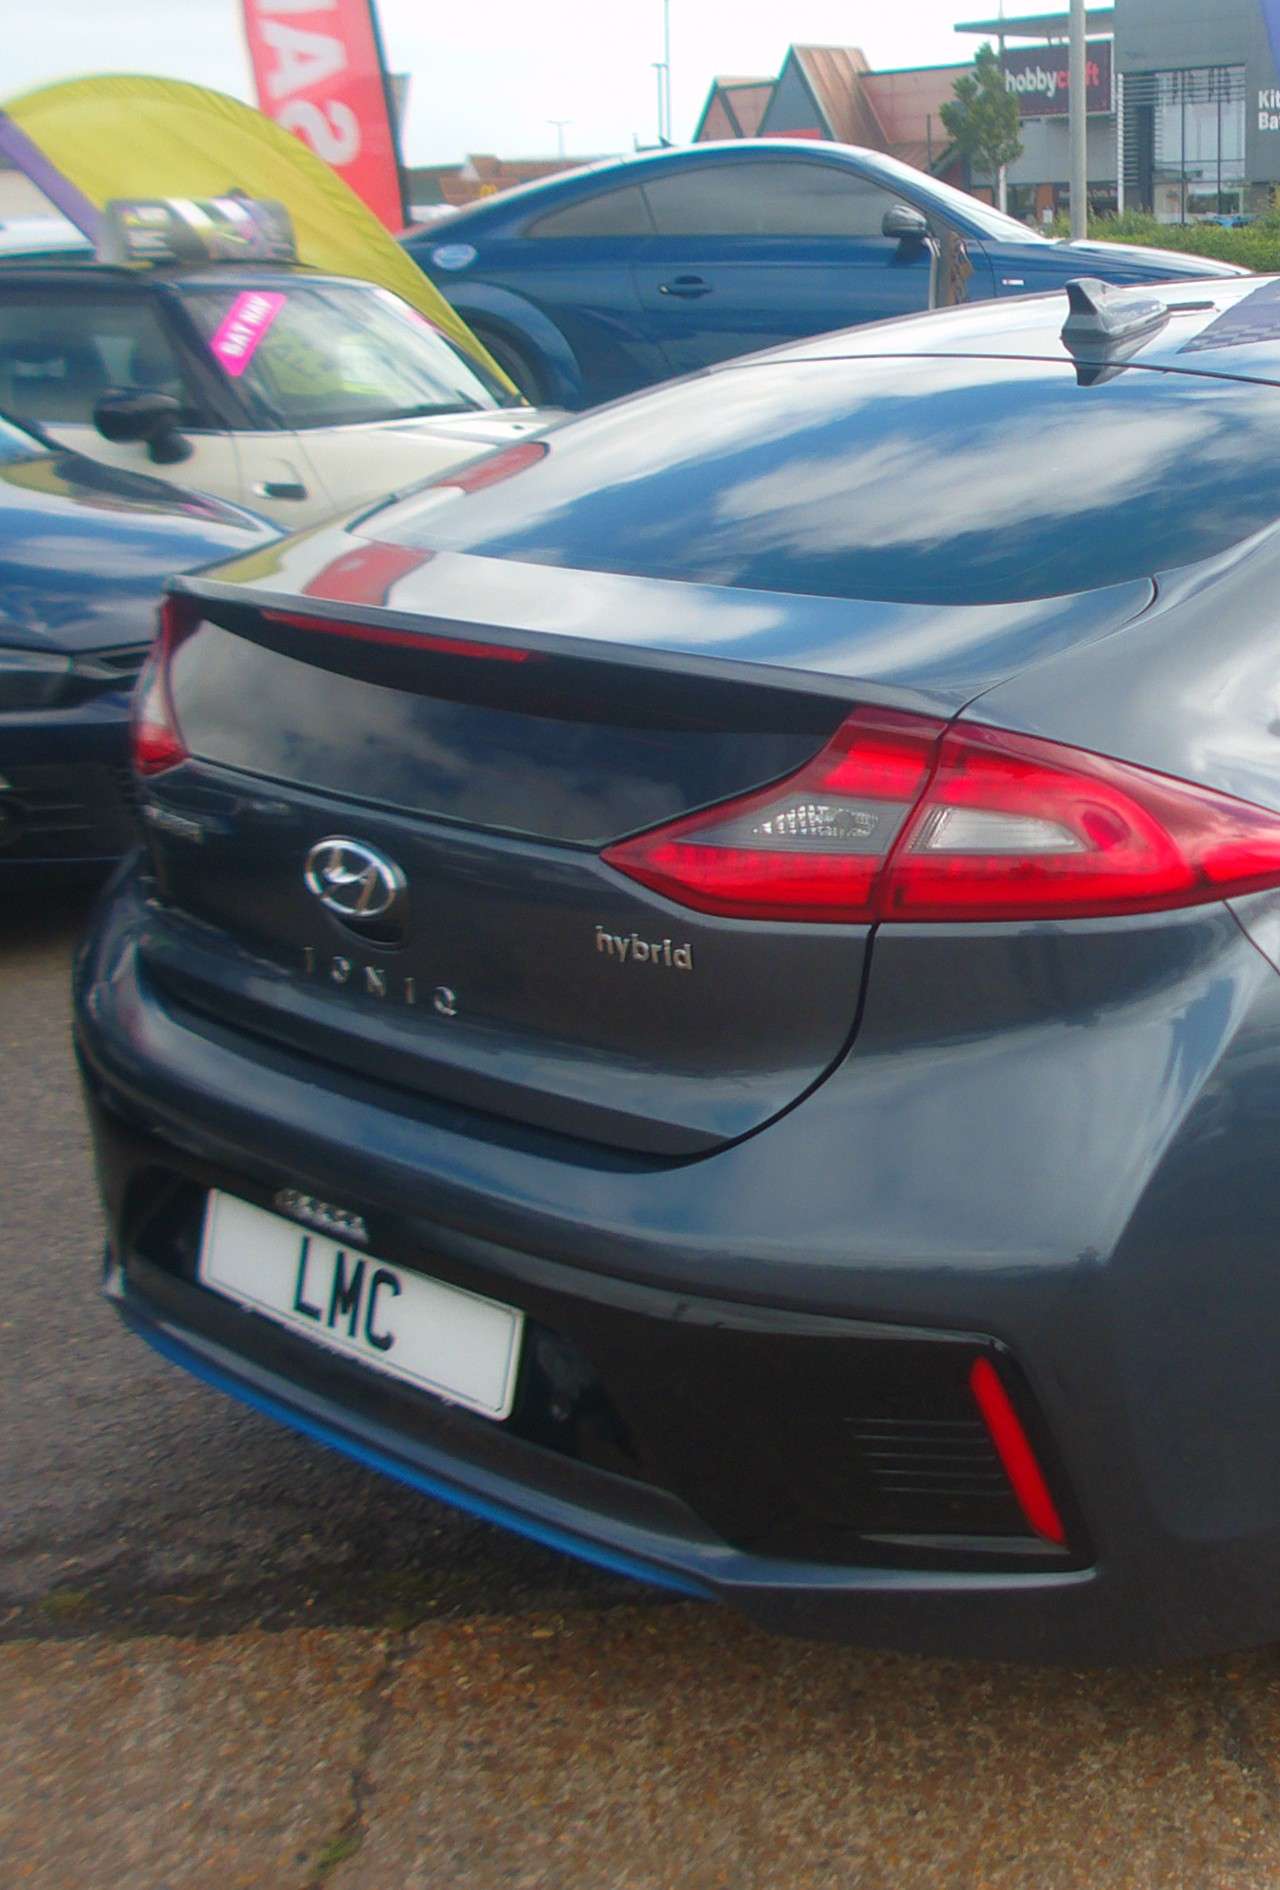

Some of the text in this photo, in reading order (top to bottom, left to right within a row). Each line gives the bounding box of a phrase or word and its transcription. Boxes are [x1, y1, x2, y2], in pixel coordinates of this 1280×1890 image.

[1004, 60, 1100, 98] hobbycft
[595, 925, 693, 970] hybrid
[304, 946, 457, 1016] IONIQ
[293, 1235, 403, 1352] LMC
